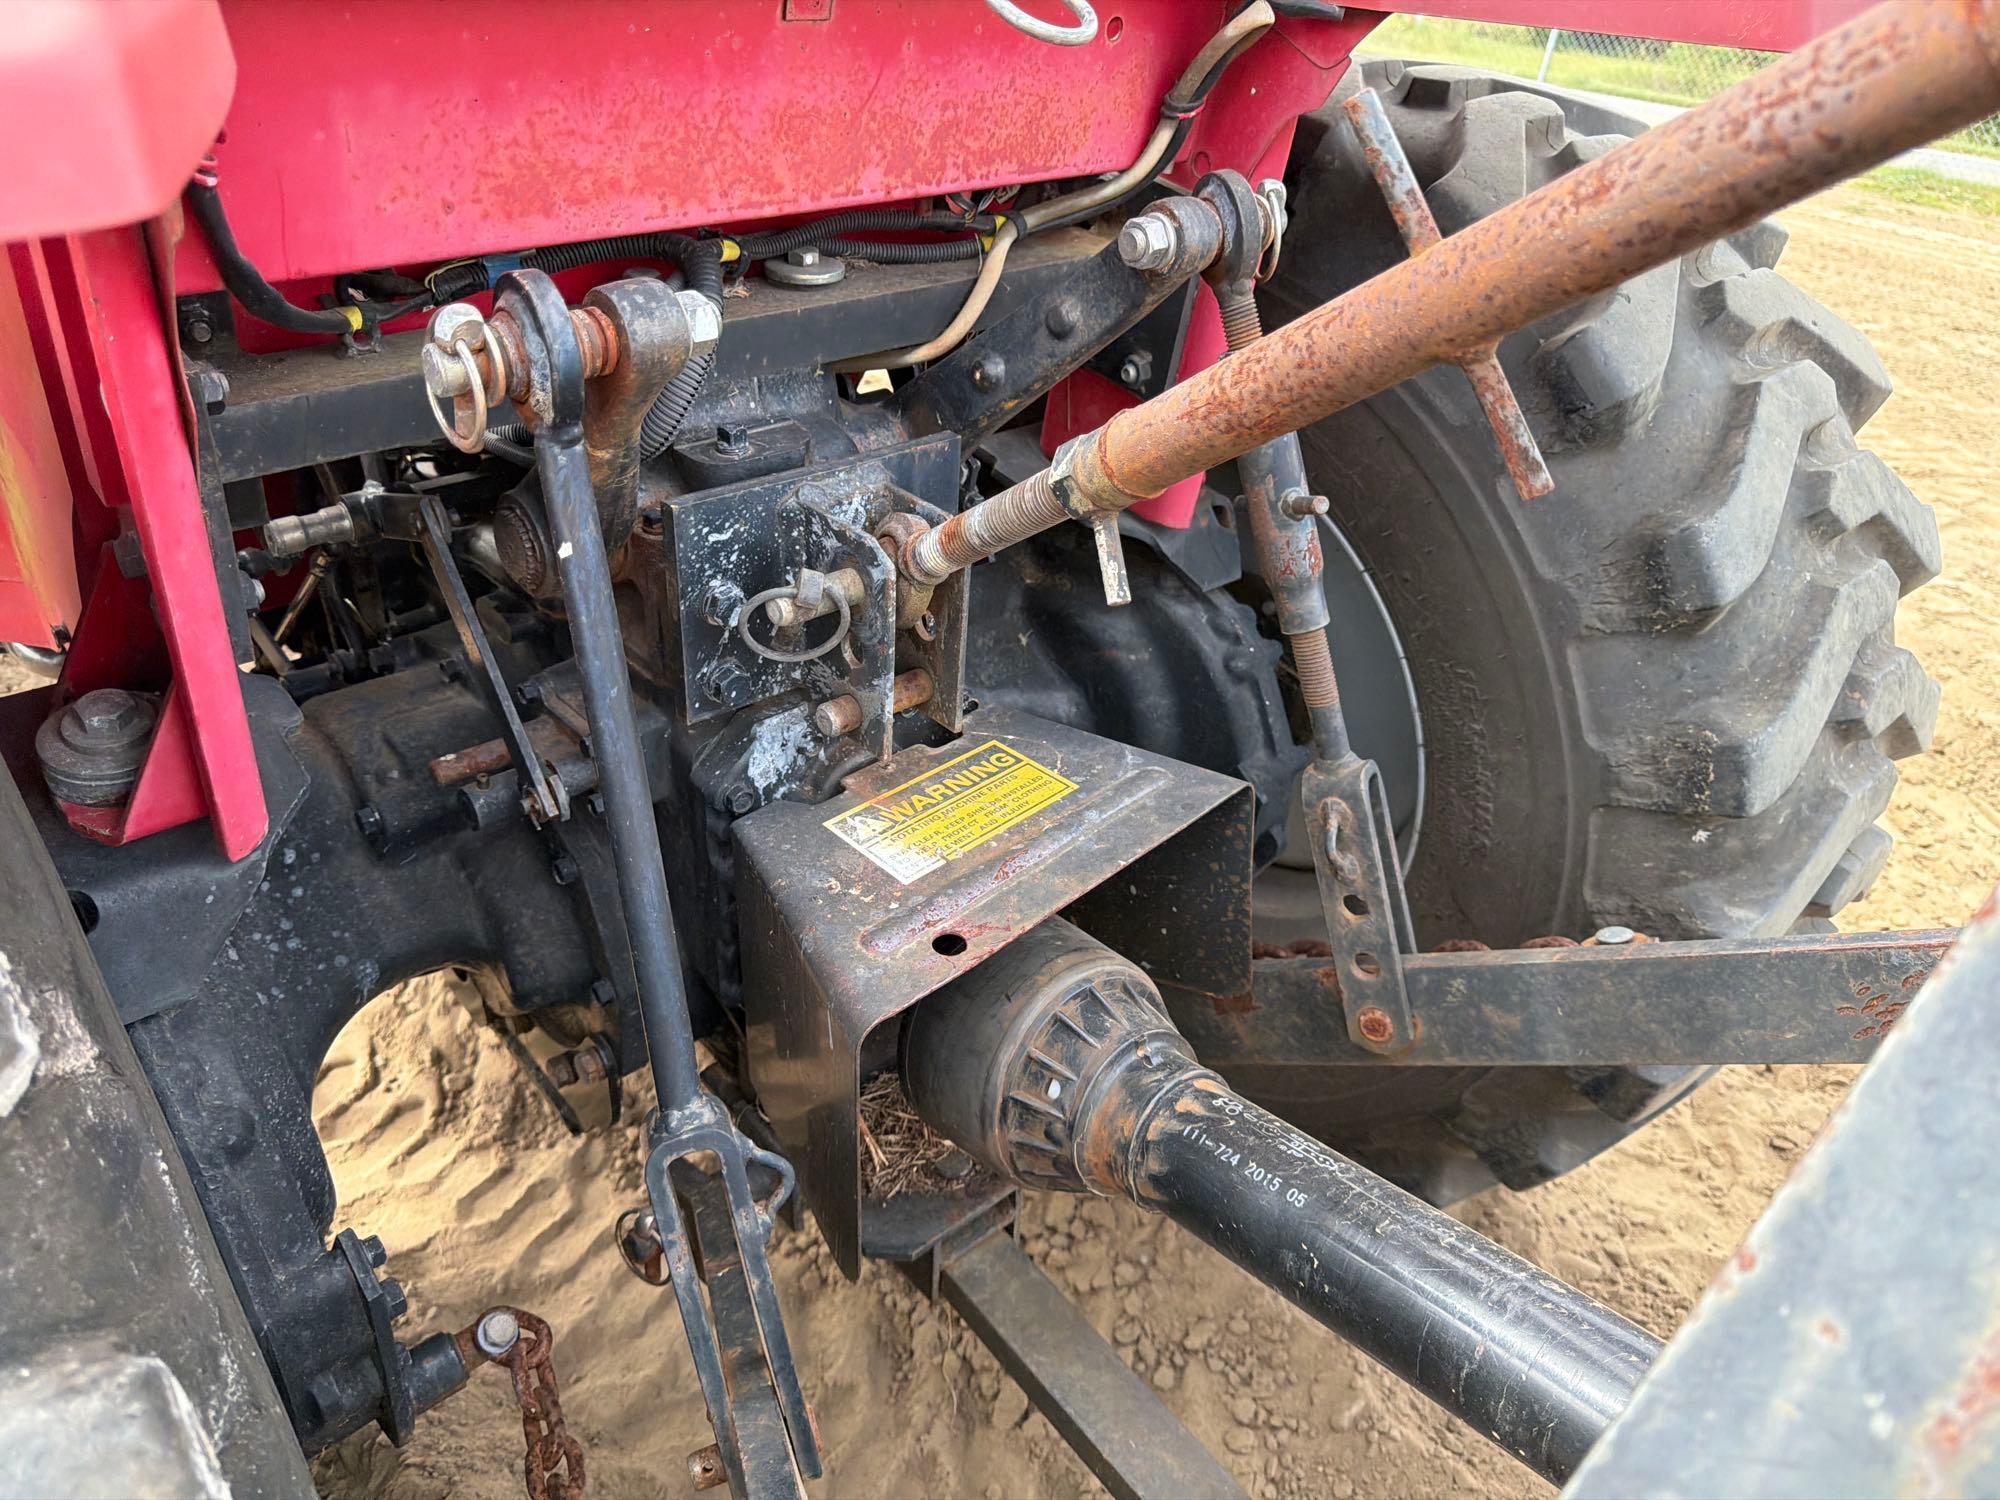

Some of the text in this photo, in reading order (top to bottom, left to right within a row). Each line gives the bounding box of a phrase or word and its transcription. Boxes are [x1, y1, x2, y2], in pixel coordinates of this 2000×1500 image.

[877, 752, 1016, 822] WARNING
[888, 774, 1019, 843] ROTATING MACHINE PARTS
[913, 840, 940, 856] HELP
[939, 818, 981, 841] PROTECT
[982, 802, 1010, 818] FROM
[1010, 779, 1053, 803] CLOTHING
[942, 816, 968, 830] KEEP
[964, 797, 1003, 818] SHIELDS
[999, 774, 1045, 799] INSTALLED
[977, 818, 999, 831] AND
[1244, 1160, 1282, 1191] 2015
[1286, 1188, 1308, 1207] 05
